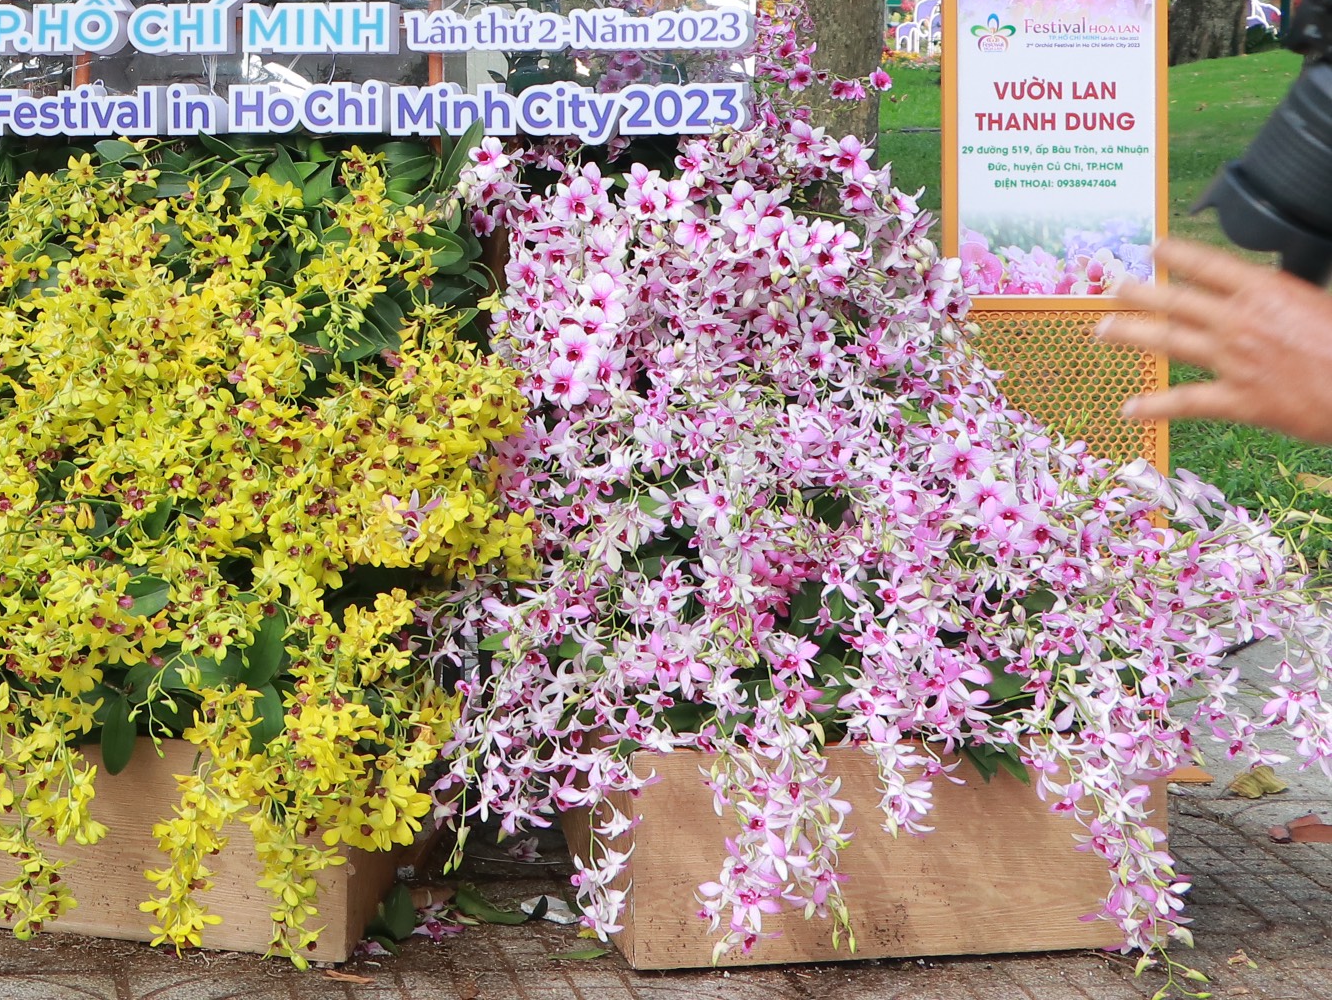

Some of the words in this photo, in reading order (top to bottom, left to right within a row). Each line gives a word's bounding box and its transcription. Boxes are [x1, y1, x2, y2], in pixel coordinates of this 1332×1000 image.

[248, 7, 386, 46] MINH
[411, 15, 468, 45] Lần
[475, 12, 535, 44] thứ
[657, 11, 742, 43] 2023
[1024, 17, 1086, 34] Festival
[1089, 24, 1116, 34] HOA
[1119, 24, 1141, 34] LAN
[993, 76, 1063, 100] VƯỜN
[1072, 81, 1117, 100] LAN
[172, 88, 211, 130] in
[234, 90, 295, 127] Ho
[304, 87, 377, 127] Chi
[396, 89, 517, 130] Minh
[521, 87, 616, 140] City
[625, 87, 740, 128] 2023
[975, 112, 1057, 131] THANH
[1065, 112, 1136, 131] DUNG
[961, 145, 974, 154] 29
[976, 144, 1009, 156] đường
[1011, 145, 1032, 155] 519,
[1035, 143, 1049, 156] ấp
[1052, 145, 1071, 154] Bàu
[1074, 145, 1098, 155] Tròn,
[1117, 145, 1149, 156] Nhuận
[987, 162, 1011, 172] Đức,
[1013, 162, 1044, 173] huyện
[1046, 161, 1061, 171] Củ
[1063, 162, 1084, 172] Chi,
[1086, 162, 1124, 171] TP.HCM
[994, 177, 1018, 190] ĐIỆN
[1020, 179, 1054, 190] THOẠI:
[1056, 179, 1117, 188] 0938947404
